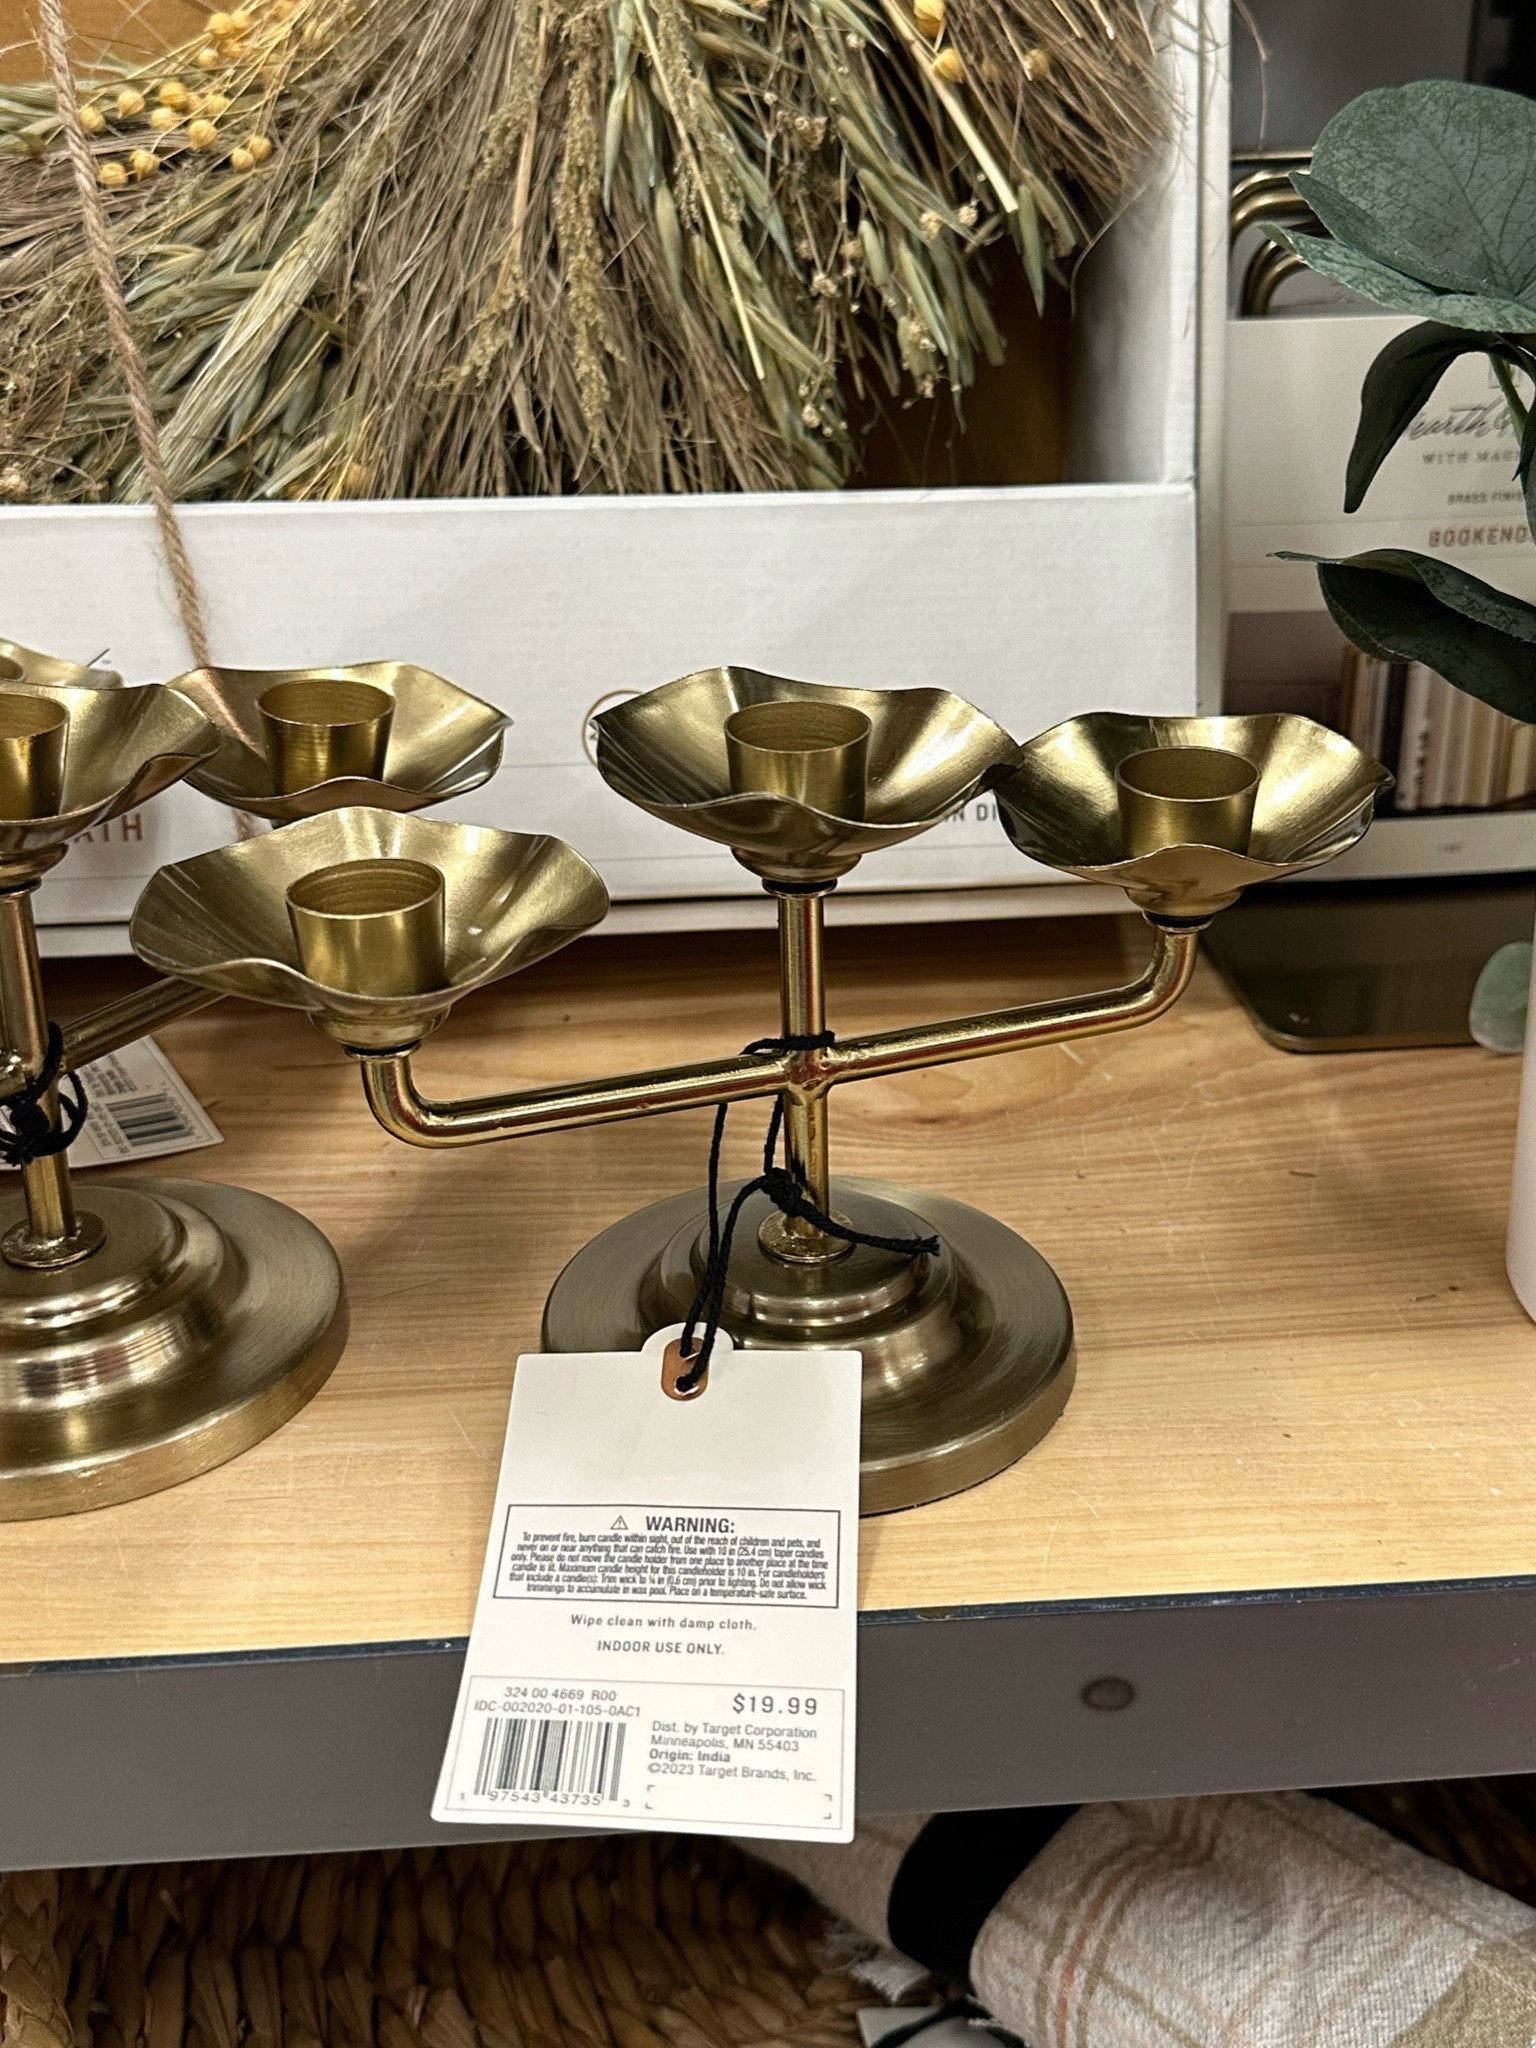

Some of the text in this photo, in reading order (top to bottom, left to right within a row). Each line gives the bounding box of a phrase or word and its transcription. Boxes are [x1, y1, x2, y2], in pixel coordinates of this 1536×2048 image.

[646, 1516, 735, 1533] WARNING:
[523, 1532, 821, 1549] To prevent fire, burn candle within sight, out of the reach of children and pets, and
[551, 1544, 558, 1552] or
[579, 1544, 611, 1554] anything
[614, 1544, 628, 1553] that
[630, 1545, 643, 1553] can
[645, 1544, 666, 1553] catch
[668, 1544, 682, 1554] fire.
[684, 1545, 697, 1555] Use
[699, 1546, 716, 1555] with
[718, 1546, 726, 1555] 10
[729, 1547, 735, 1556] in
[738, 1547, 756, 1557] (25.4
[758, 1548, 771, 1557] cm)
[774, 1549, 793, 1559] taper
[795, 1549, 824, 1558] candles
[511, 1553, 828, 1569] only. Please do not move the candle holder from one place to another place at the time
[512, 1562, 825, 1579] candle is lit. Maximum candle height for this candleholder is 10 in. For candleholders
[571, 1615, 757, 1631] Wipe clean with damp cloth.
[597, 1640, 725, 1655] INDOOR USE ONLY.
[504, 1687, 617, 1701] 324 00 4669 R00
[474, 1700, 641, 1717] IDC-002020-01-105-0AC1
[732, 1692, 818, 1715] $19.99
[652, 1720, 817, 1738] Dist. by Target Corporation
[650, 1735, 800, 1752] Minneapolis, MN 55403
[649, 1748, 731, 1763] Origin: India
[648, 1763, 817, 1782] ©2023 Target Brands, Inc.
